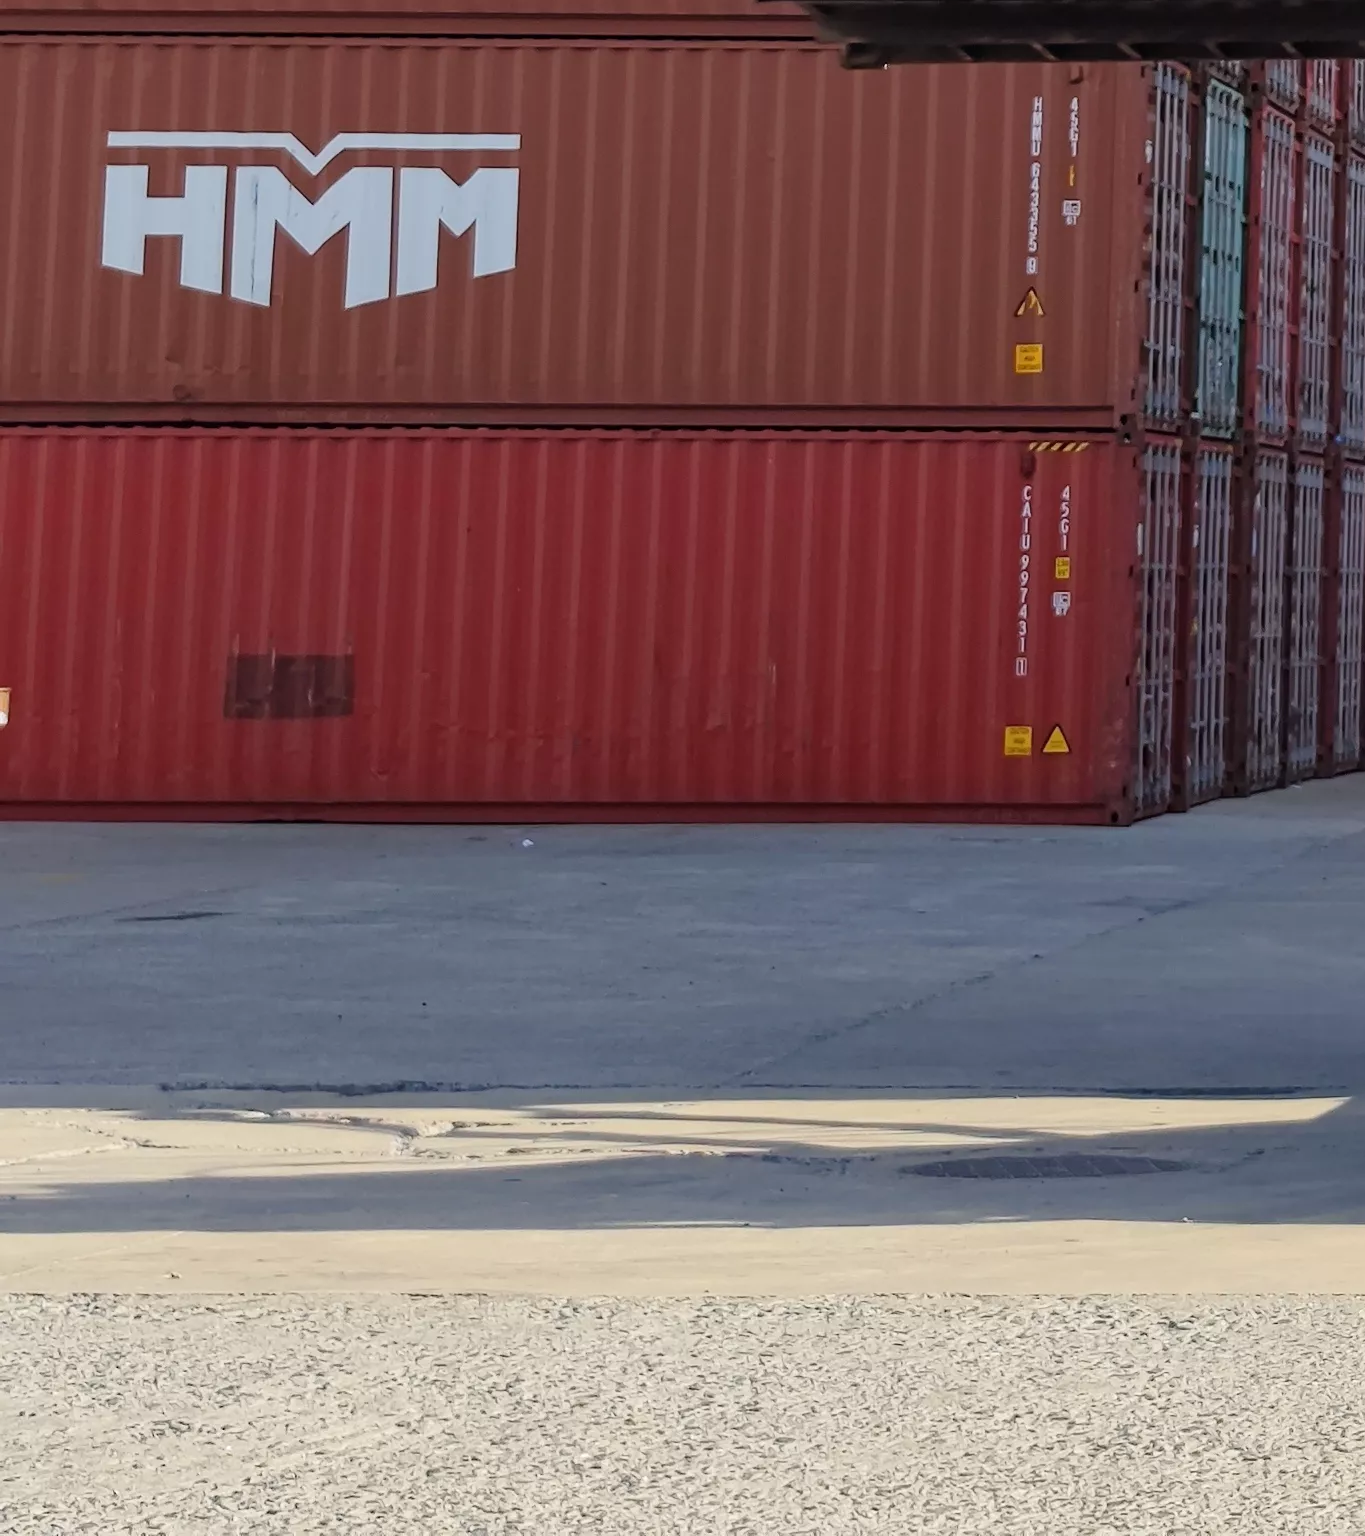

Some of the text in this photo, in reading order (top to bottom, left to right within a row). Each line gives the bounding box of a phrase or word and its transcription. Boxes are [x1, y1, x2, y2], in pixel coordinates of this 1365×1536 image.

[101, 162, 522, 310] HMM
[1019, 485, 1032, 550] CAIU
[1059, 485, 1071, 551] 45G1
[1017, 554, 1030, 653] 997431
